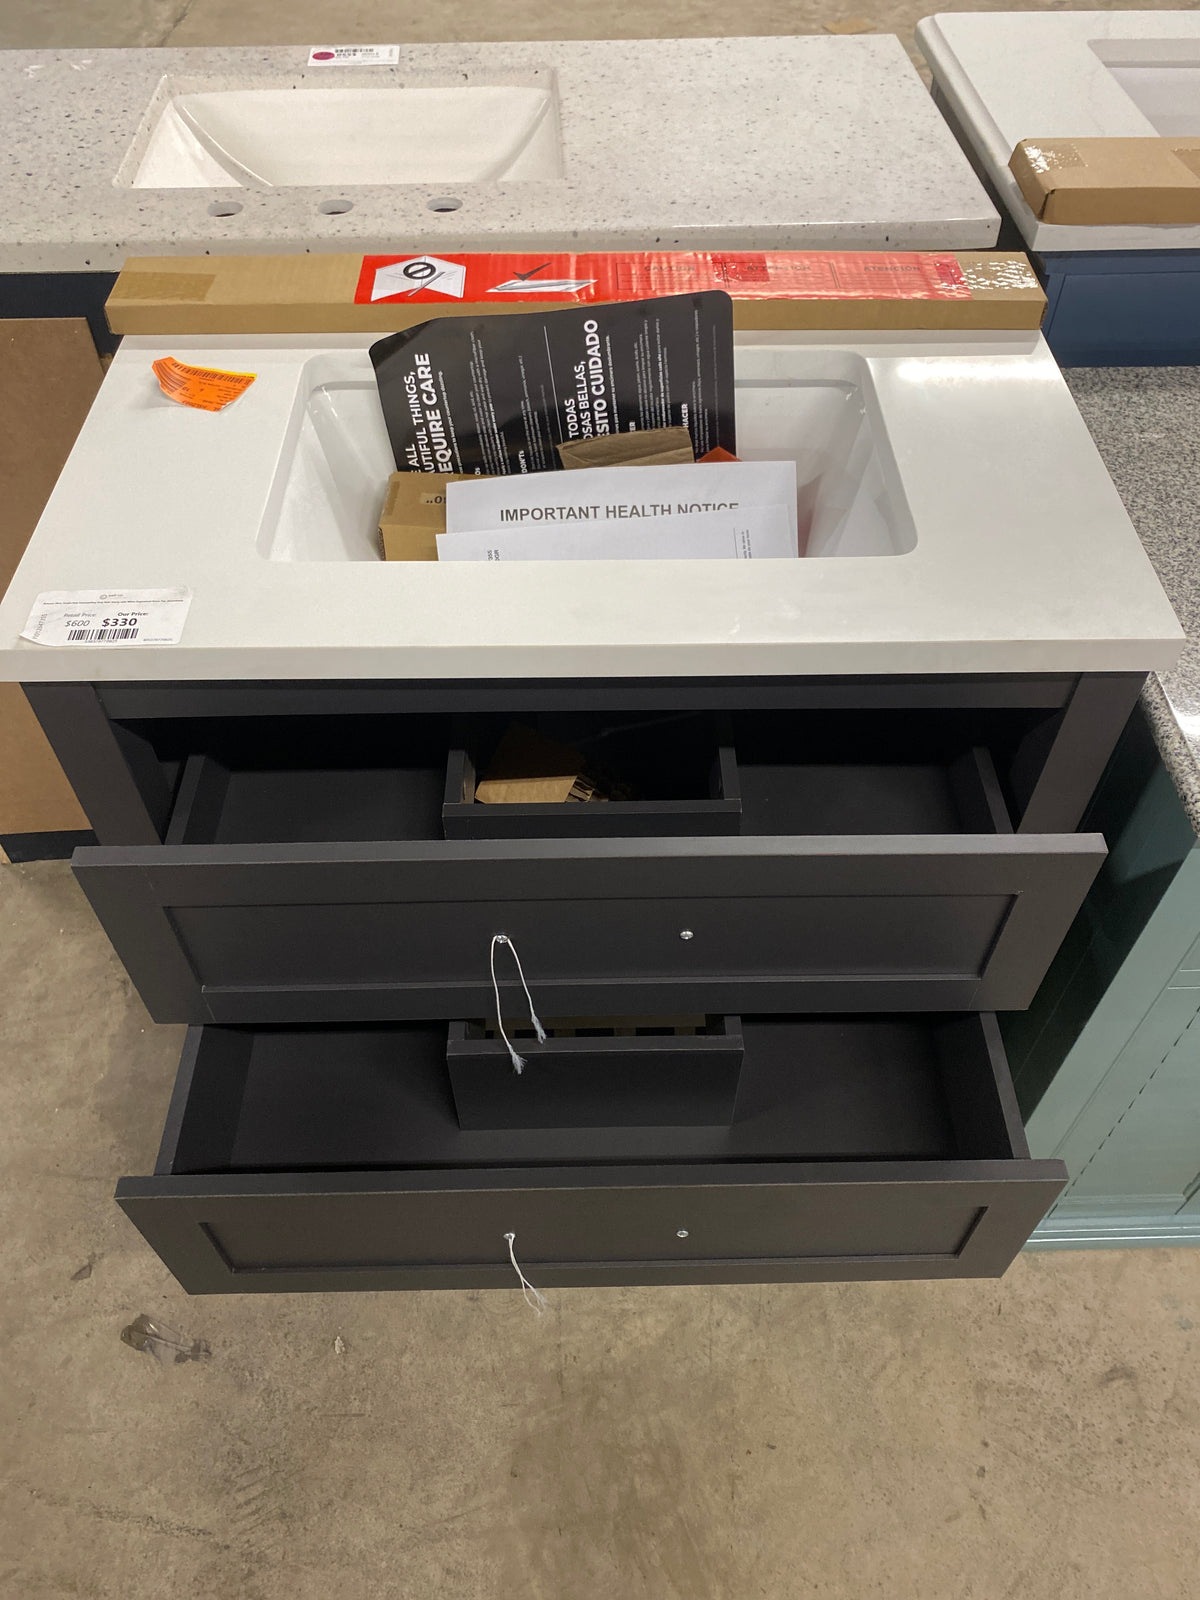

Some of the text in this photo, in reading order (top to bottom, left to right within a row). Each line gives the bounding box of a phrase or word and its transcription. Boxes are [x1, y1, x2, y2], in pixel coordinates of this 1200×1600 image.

[584, 320, 605, 395] CUIDADO
[404, 372, 423, 425] THINGS,
[574, 362, 589, 409] BELLAS,
[415, 354, 453, 474] EQUIRE CARE
[565, 399, 578, 437] TODAS
[406, 444, 419, 466] ALL
[500, 506, 600, 521] IMPORTANT
[606, 504, 672, 519] HEALTH
[65, 619, 90, 627] $600
[101, 618, 138, 628] $330
